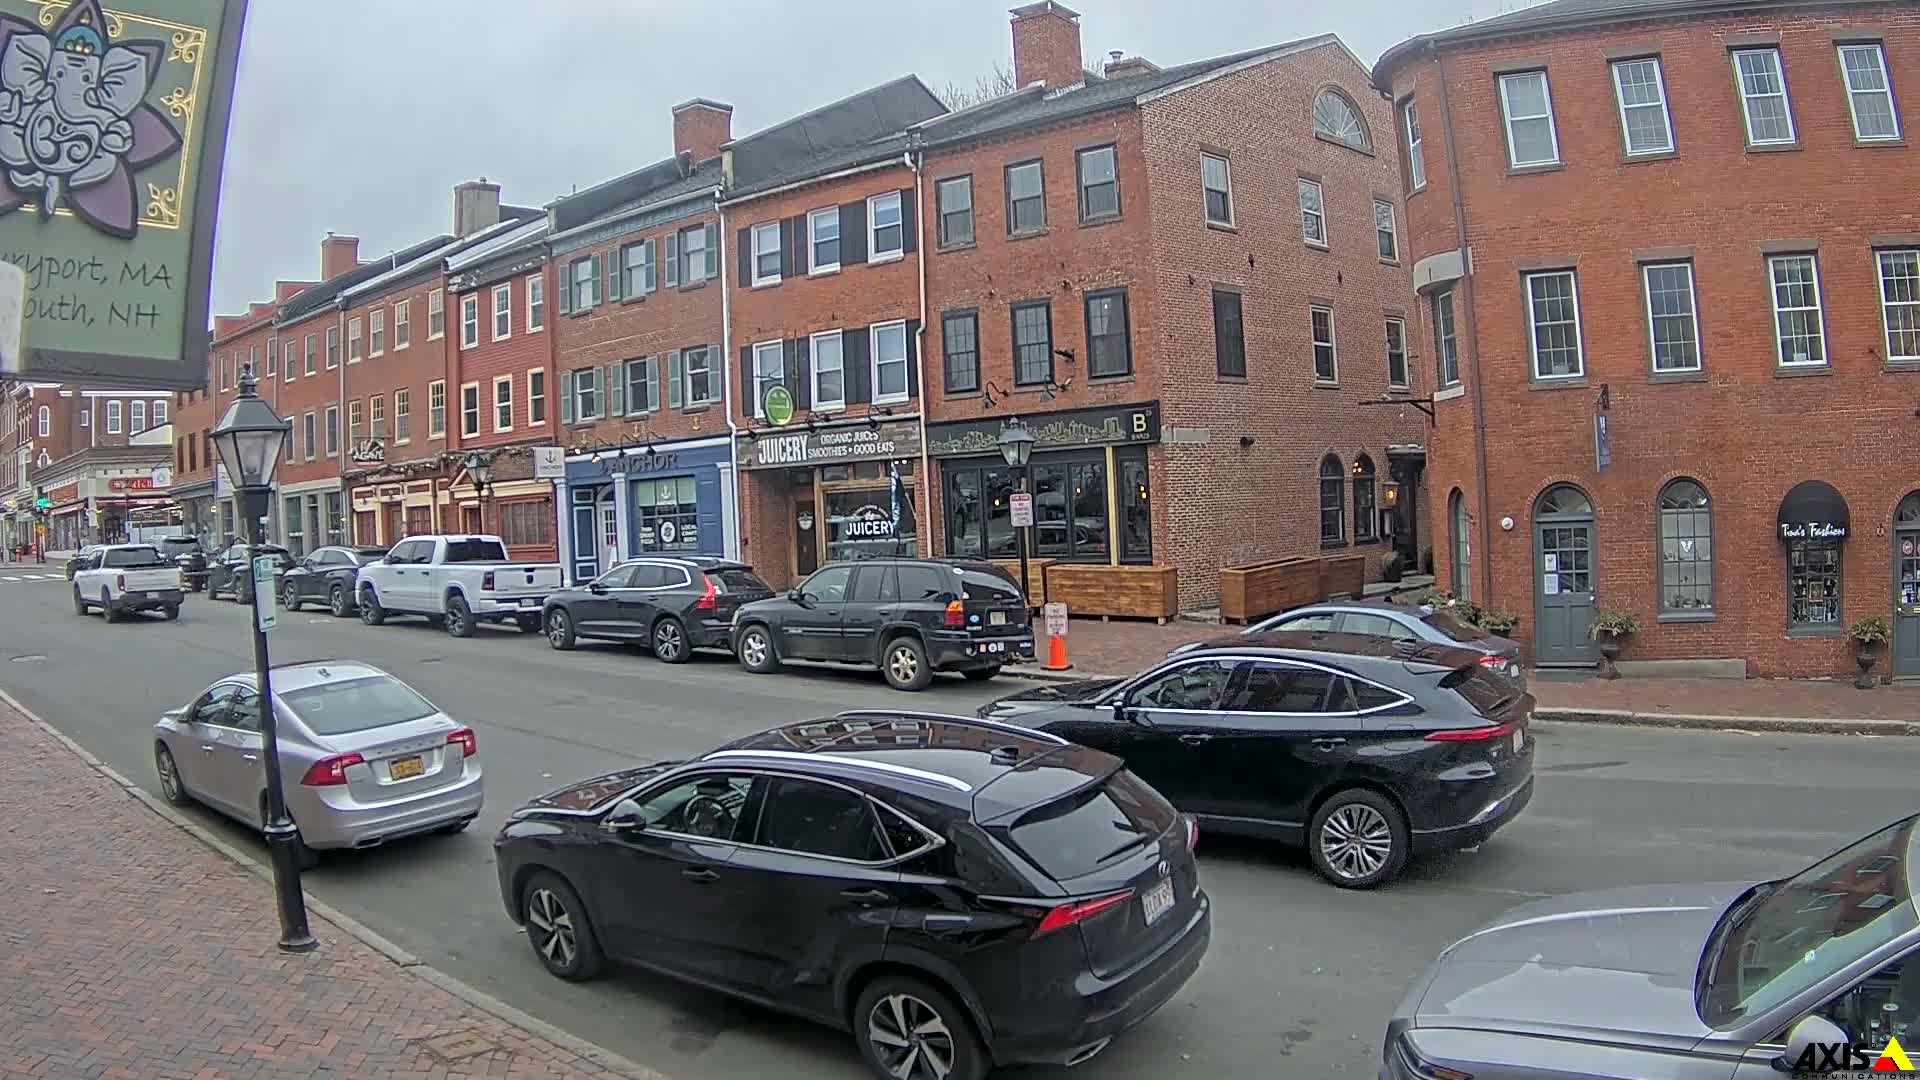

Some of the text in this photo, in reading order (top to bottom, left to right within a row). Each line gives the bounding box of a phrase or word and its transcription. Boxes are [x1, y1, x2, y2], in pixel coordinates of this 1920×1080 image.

[0, 252, 172, 291] ryport, MA
[108, 301, 160, 329] NH
[821, 430, 878, 445] ORGANIC JUICES
[758, 435, 808, 464] JUICERY
[808, 441, 894, 458] SMOOTHIES GOOD EATS
[845, 520, 895, 536] JUICERY
